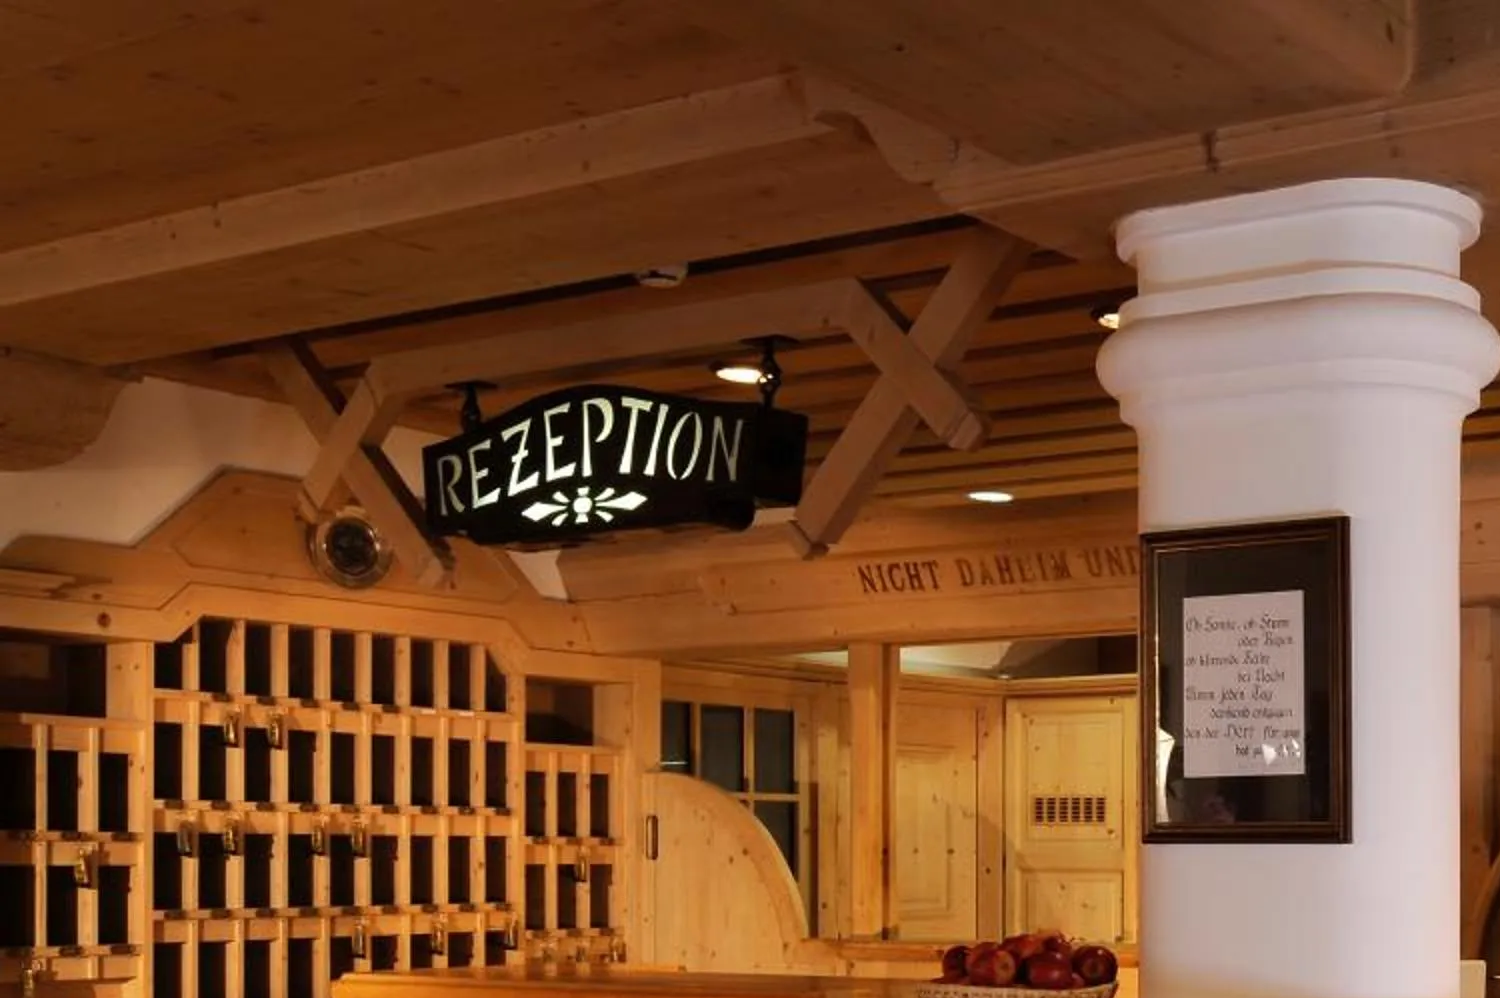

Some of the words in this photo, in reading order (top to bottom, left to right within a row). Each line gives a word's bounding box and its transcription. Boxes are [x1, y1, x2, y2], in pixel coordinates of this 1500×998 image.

[436, 396, 744, 516] REZEPTION
[857, 559, 940, 593] NICHT
[955, 552, 1073, 587] DAHEIM
